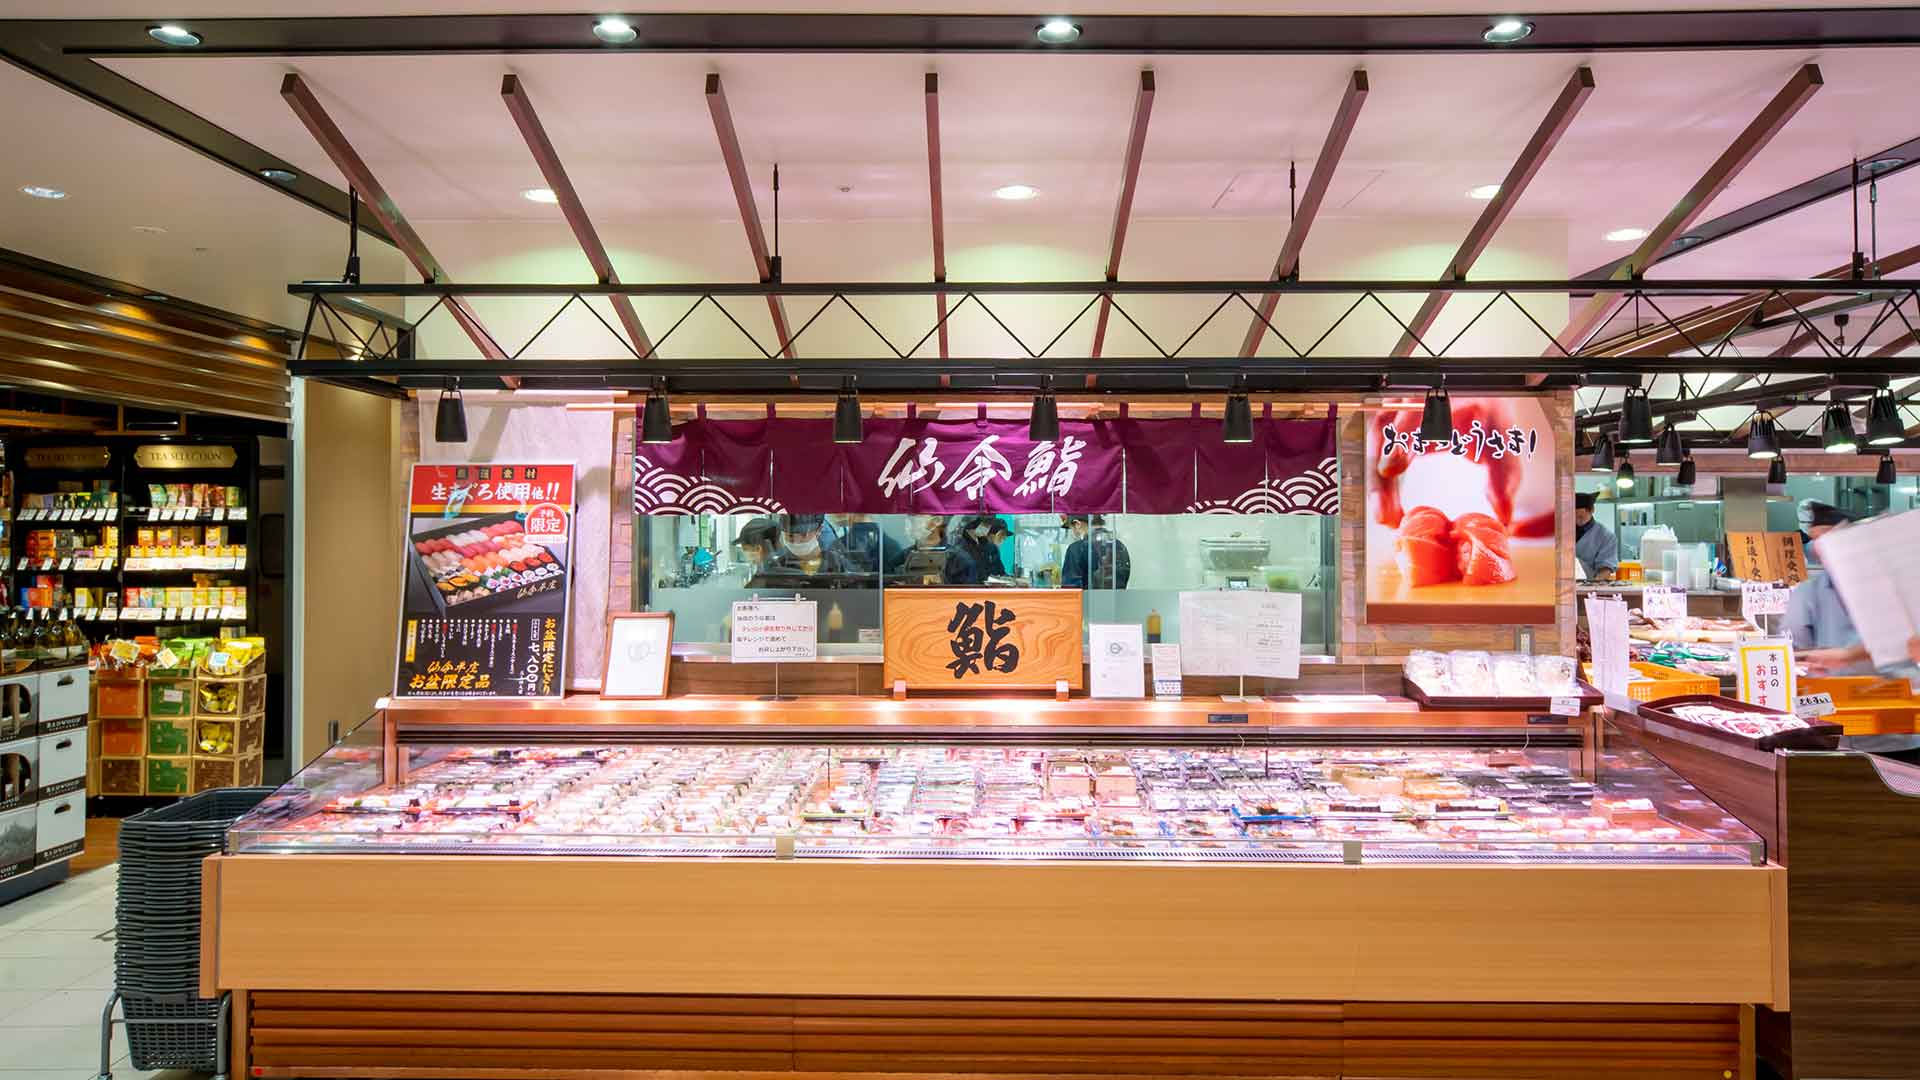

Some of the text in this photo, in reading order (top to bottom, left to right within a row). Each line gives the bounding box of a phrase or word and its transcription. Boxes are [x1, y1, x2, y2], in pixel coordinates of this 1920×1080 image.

[171, 452, 222, 460] SELECTION
[878, 435, 1087, 500] 仙令鮨
[531, 519, 561, 532] 限定
[945, 600, 1019, 678] 鮨
[409, 673, 490, 689] お盆限定品
[1769, 653, 1779, 687] 本日の
